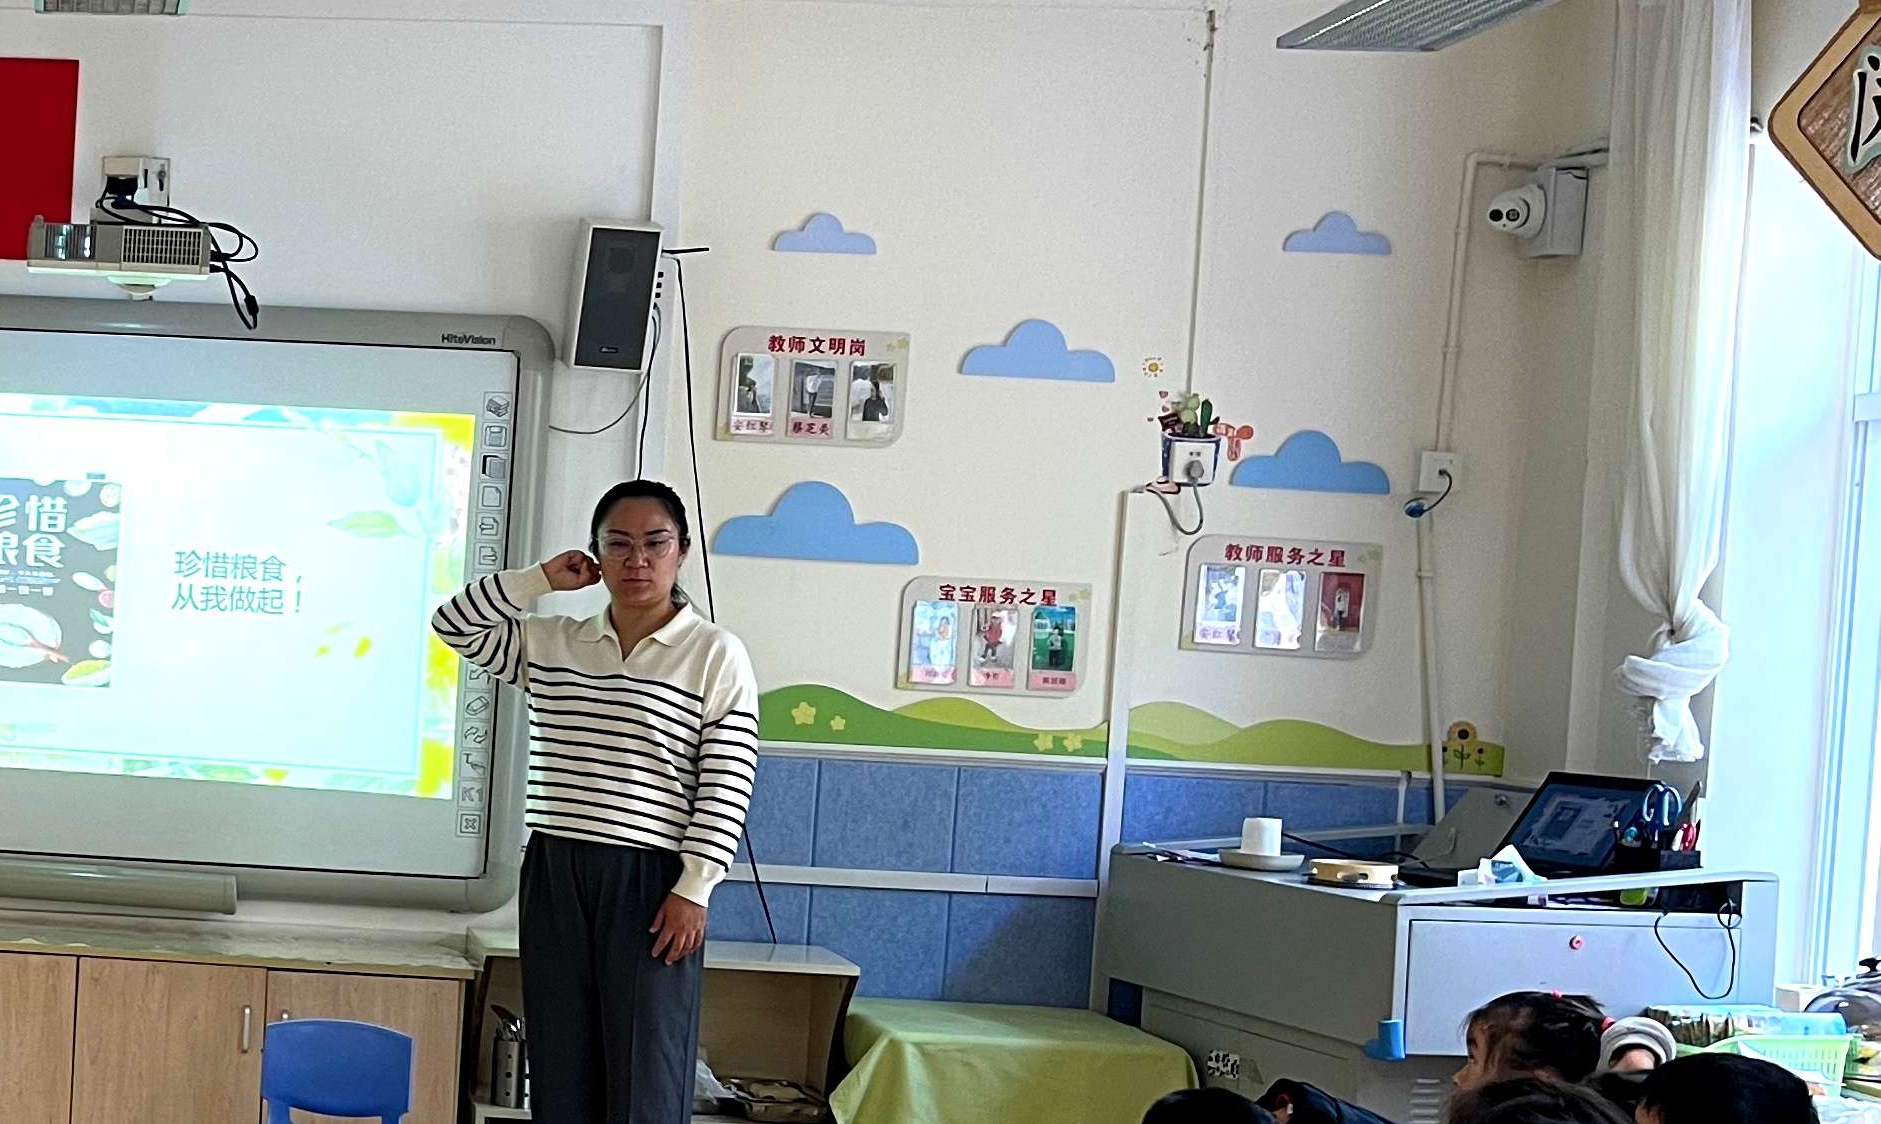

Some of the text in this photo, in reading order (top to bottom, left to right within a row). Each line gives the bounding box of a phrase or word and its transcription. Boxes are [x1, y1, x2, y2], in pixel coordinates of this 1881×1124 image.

[768, 335, 866, 357] 教师文明岗
[1224, 543, 1346, 567] 教师服务之星
[171, 582, 302, 615] 从我做起！
[938, 584, 1057, 607] 宝宝服务之星
